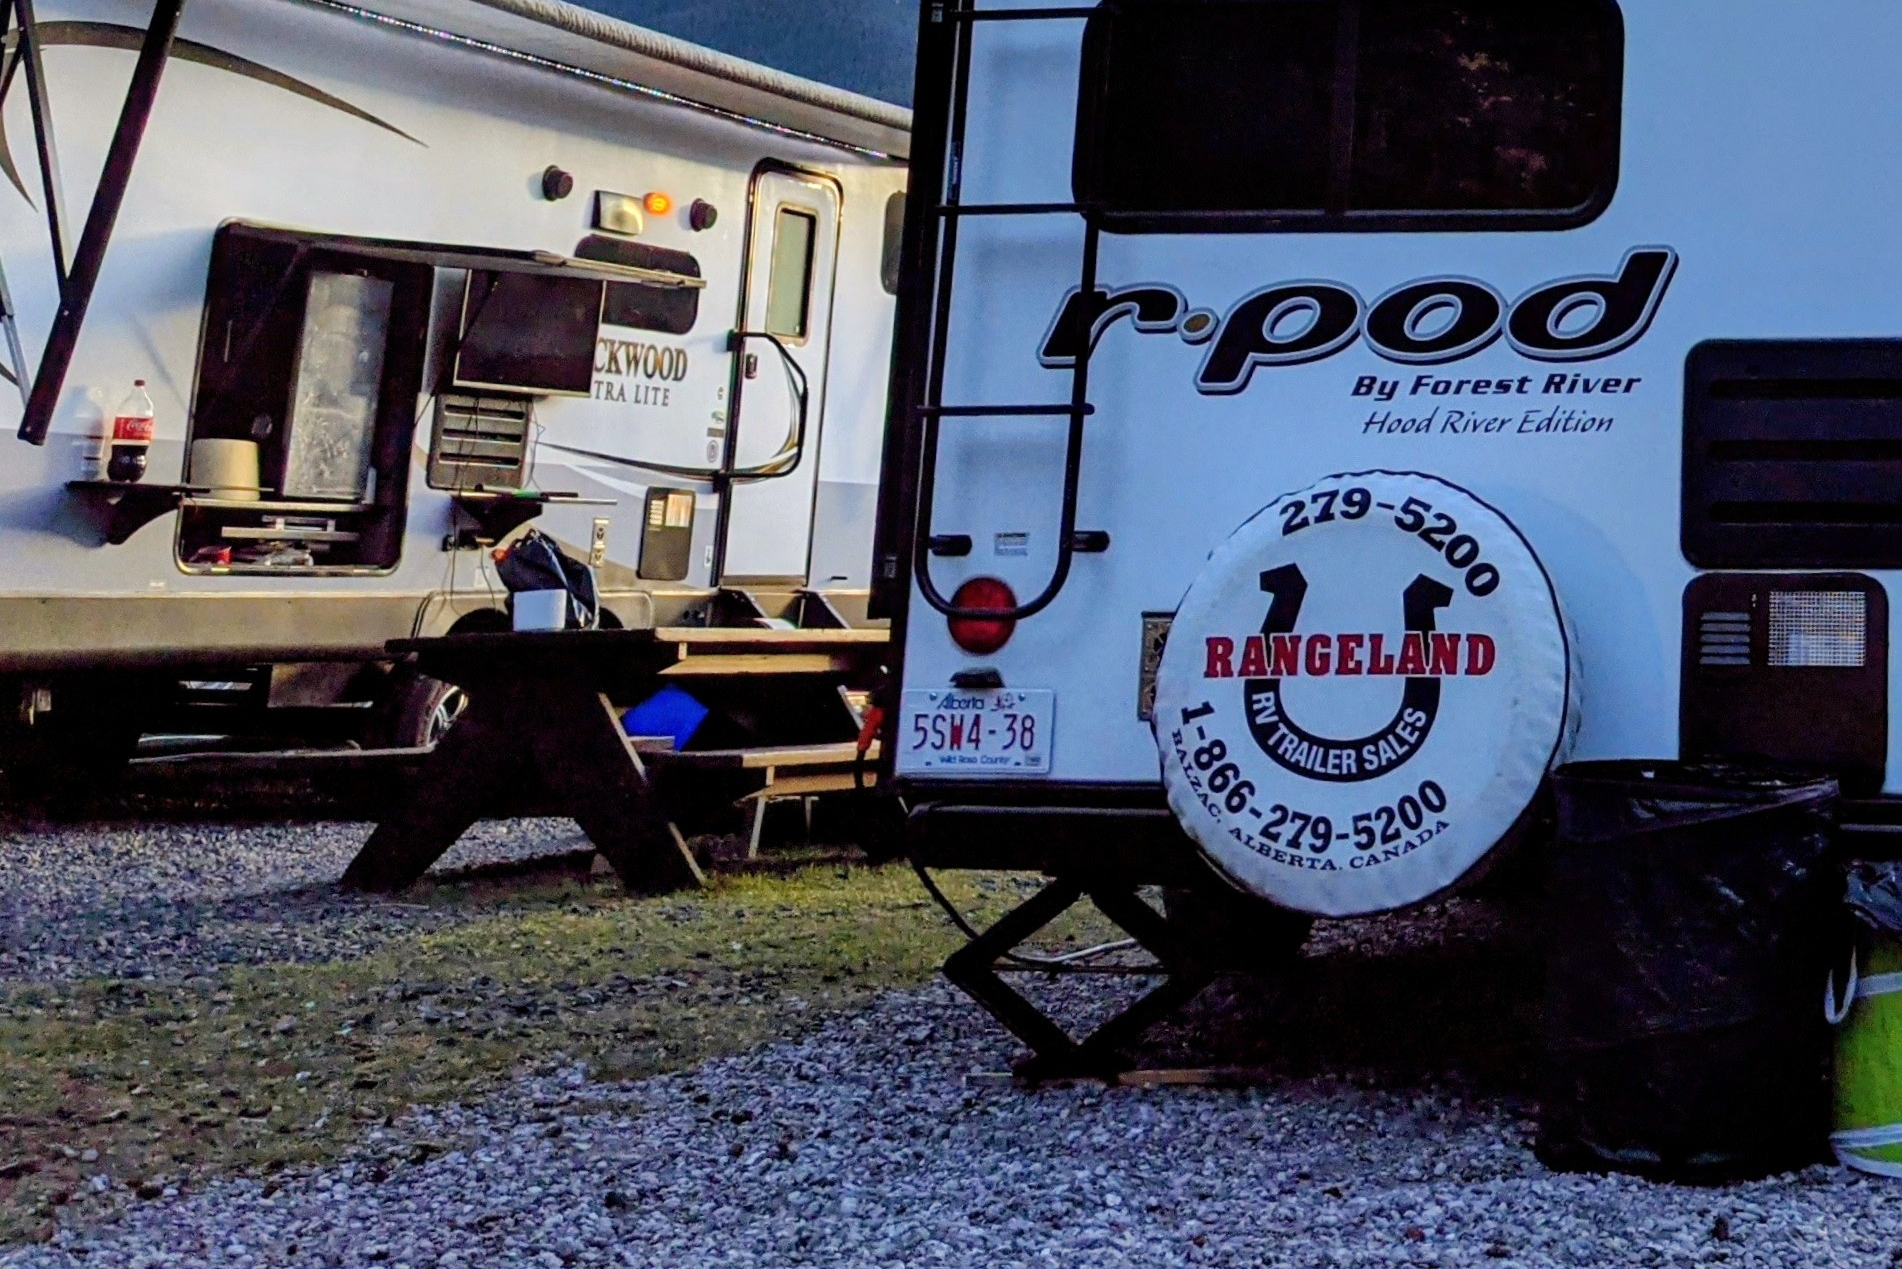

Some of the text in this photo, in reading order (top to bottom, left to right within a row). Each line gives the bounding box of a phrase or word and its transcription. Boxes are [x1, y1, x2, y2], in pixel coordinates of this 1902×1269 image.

[594, 337, 688, 383] CKWOOD
[594, 379, 670, 407] TRA LITE
[1350, 372, 1642, 401] By Forest River
[1361, 405, 1614, 434] Hood River Edition
[1279, 487, 1500, 597] 279-5200
[1203, 632, 1496, 679] RANGELAND
[937, 692, 985, 710] Alberta
[1251, 691, 1427, 775] RV TRAILER SALES
[1180, 701, 1447, 854] 1-866-279-5200
[1349, 819, 1450, 869] CANADA
